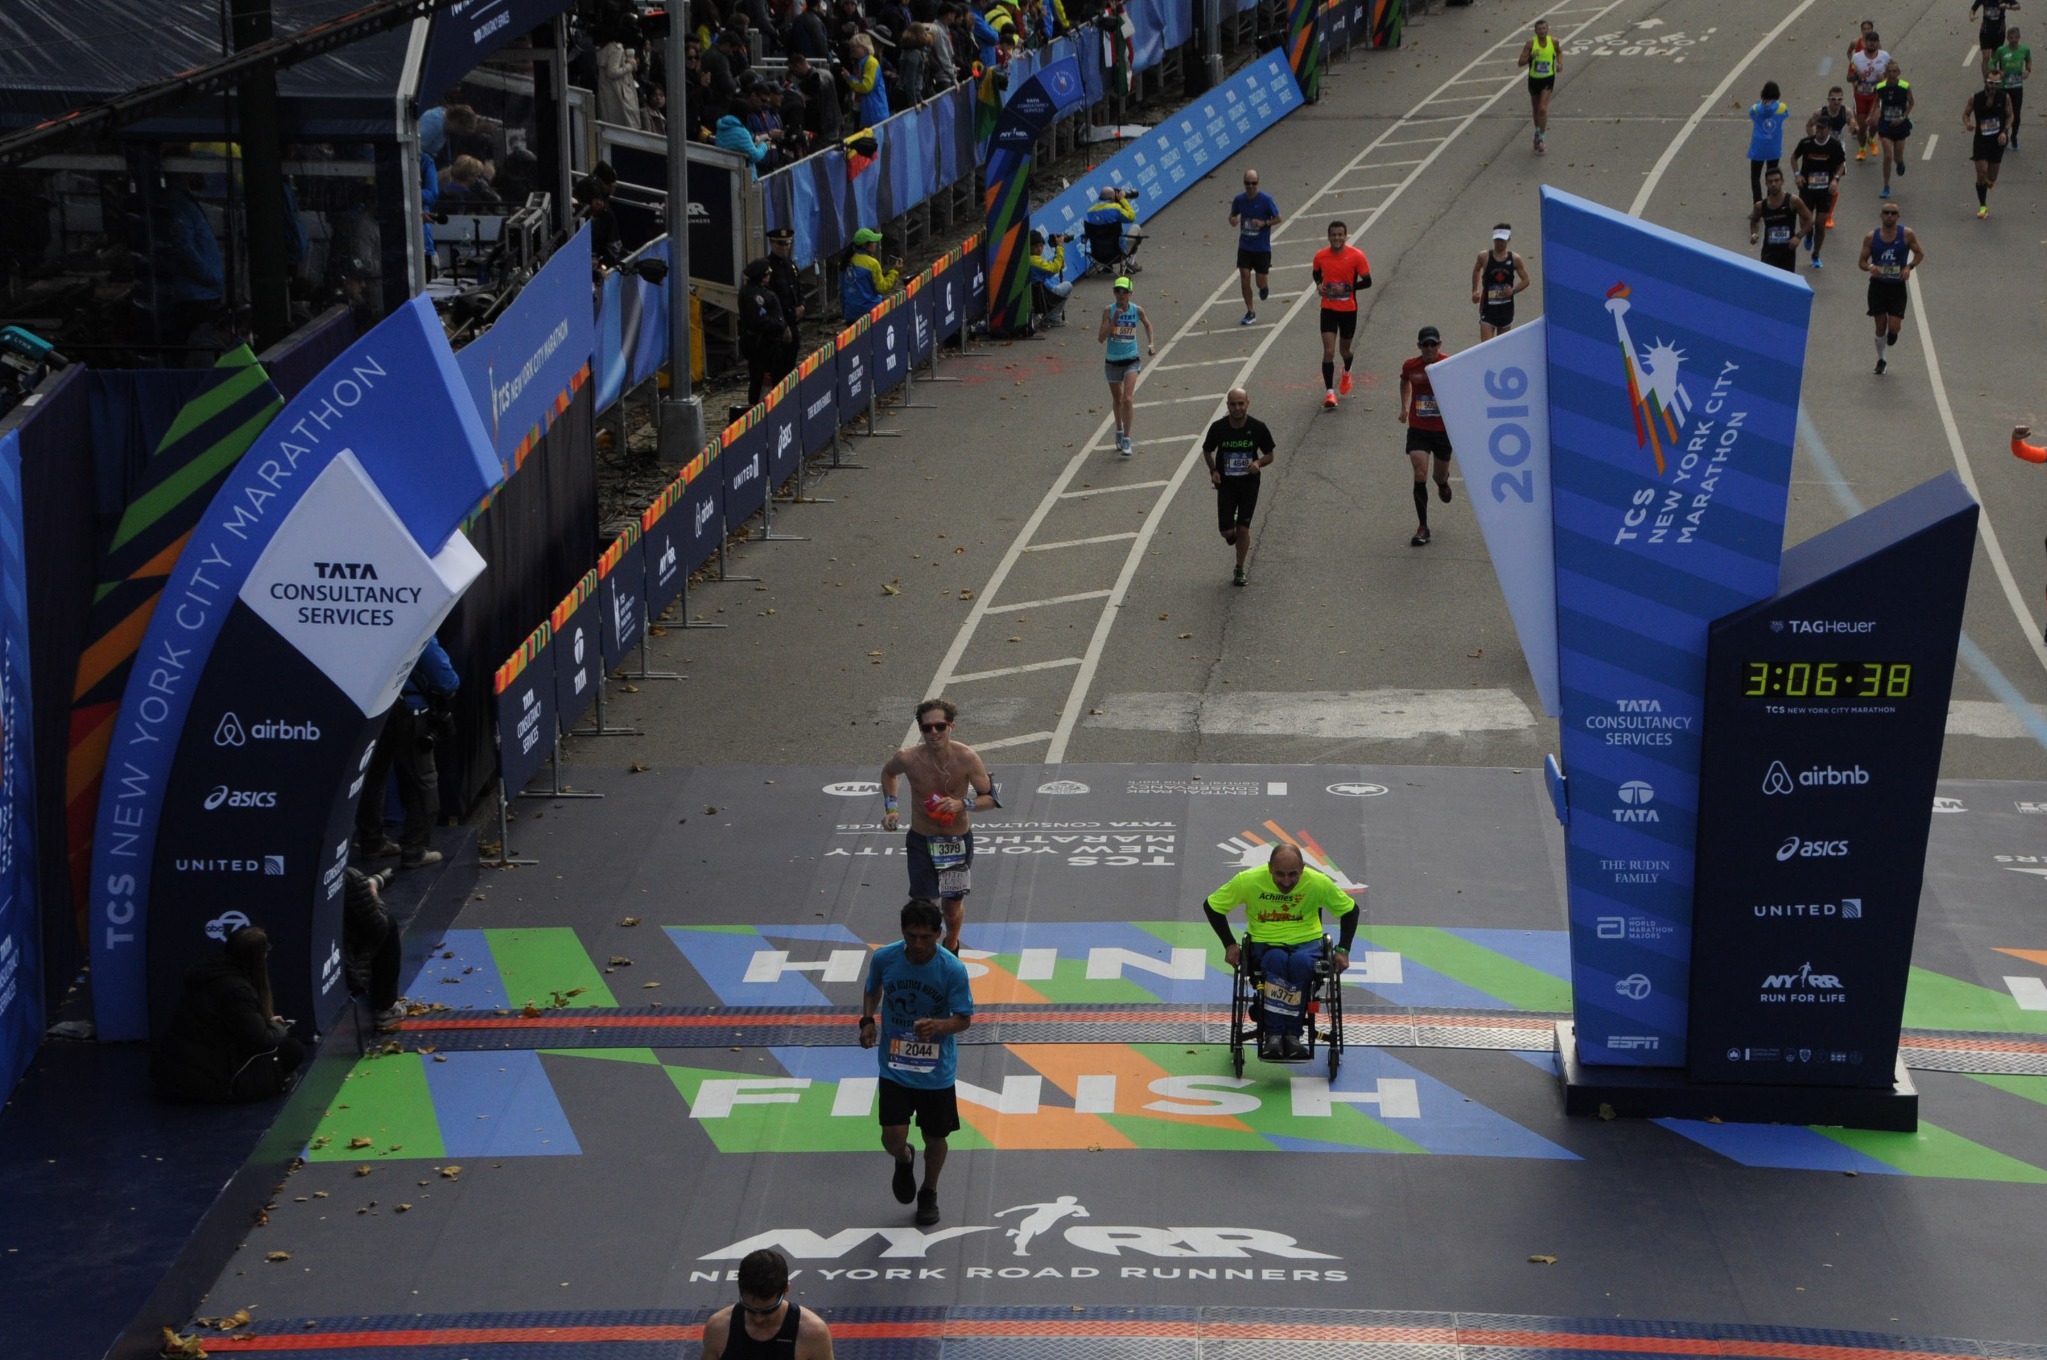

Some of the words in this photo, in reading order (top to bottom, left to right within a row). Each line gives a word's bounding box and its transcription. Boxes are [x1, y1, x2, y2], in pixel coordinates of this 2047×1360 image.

[498, 381, 510, 417] TCS
[1483, 366, 1534, 504] 2016
[224, 354, 388, 540] MARATHON
[1221, 440, 1254, 448] ANDREA
[1648, 490, 1683, 544] NEW
[1673, 420, 1715, 484] YORK
[1705, 360, 1740, 414] CITY
[733, 463, 753, 491] UNITED
[1676, 411, 1748, 544] MARATHON
[1614, 488, 1655, 545] TCS
[313, 562, 379, 580] TATA
[175, 541, 233, 631] CITY
[270, 583, 422, 604] CONSULTANCY
[298, 607, 394, 626] SERVICES
[574, 667, 587, 696] TATA
[129, 639, 191, 752] YORK
[522, 688, 535, 712] TATA
[1616, 699, 1662, 712] TATA
[1766, 705, 1785, 714] TCS
[1851, 706, 1896, 714] MARATHON
[517, 700, 542, 739] CONSULTANCY
[1585, 715, 1692, 730] CONSULTANCY
[250, 719, 321, 741] airbnb
[522, 725, 540, 756] SERVICES
[1605, 732, 1673, 746] SERVICES
[1798, 764, 1870, 786] airbnb
[227, 791, 278, 808] asics
[110, 761, 151, 857] NEW
[1611, 809, 1660, 822] TATA
[970, 821, 1101, 829] CONSULTAN
[971, 834, 1175, 845] MARATHO
[938, 843, 961, 855] 3379
[972, 845, 1060, 855] YOR
[1072, 845, 1175, 855] NEW
[1800, 840, 1849, 857] asics
[175, 859, 259, 872] UNITED
[1067, 856, 1175, 866] TCS
[1600, 859, 1626, 870] THE
[1629, 860, 1670, 870] RUDIN
[1615, 873, 1659, 883] FAMILY
[1258, 892, 1294, 902] Achilles
[106, 872, 135, 949] TCS
[1754, 904, 1837, 917] UNITED
[204, 924, 225, 933] abc
[742, 947, 1403, 983] FNIH
[1760, 993, 1786, 1003] RUN
[1790, 993, 1815, 1003] FOR
[1819, 993, 1846, 1003] LIFE
[905, 1043, 933, 1057] 2044
[1607, 1035, 1660, 1049] ESPN
[689, 1074, 1420, 1119] FINISH
[689, 1268, 803, 1283] NE
[818, 1268, 948, 1281] YORK
[966, 1266, 1100, 1279] ROAD
[1120, 1267, 1349, 1282] RUNNERS
